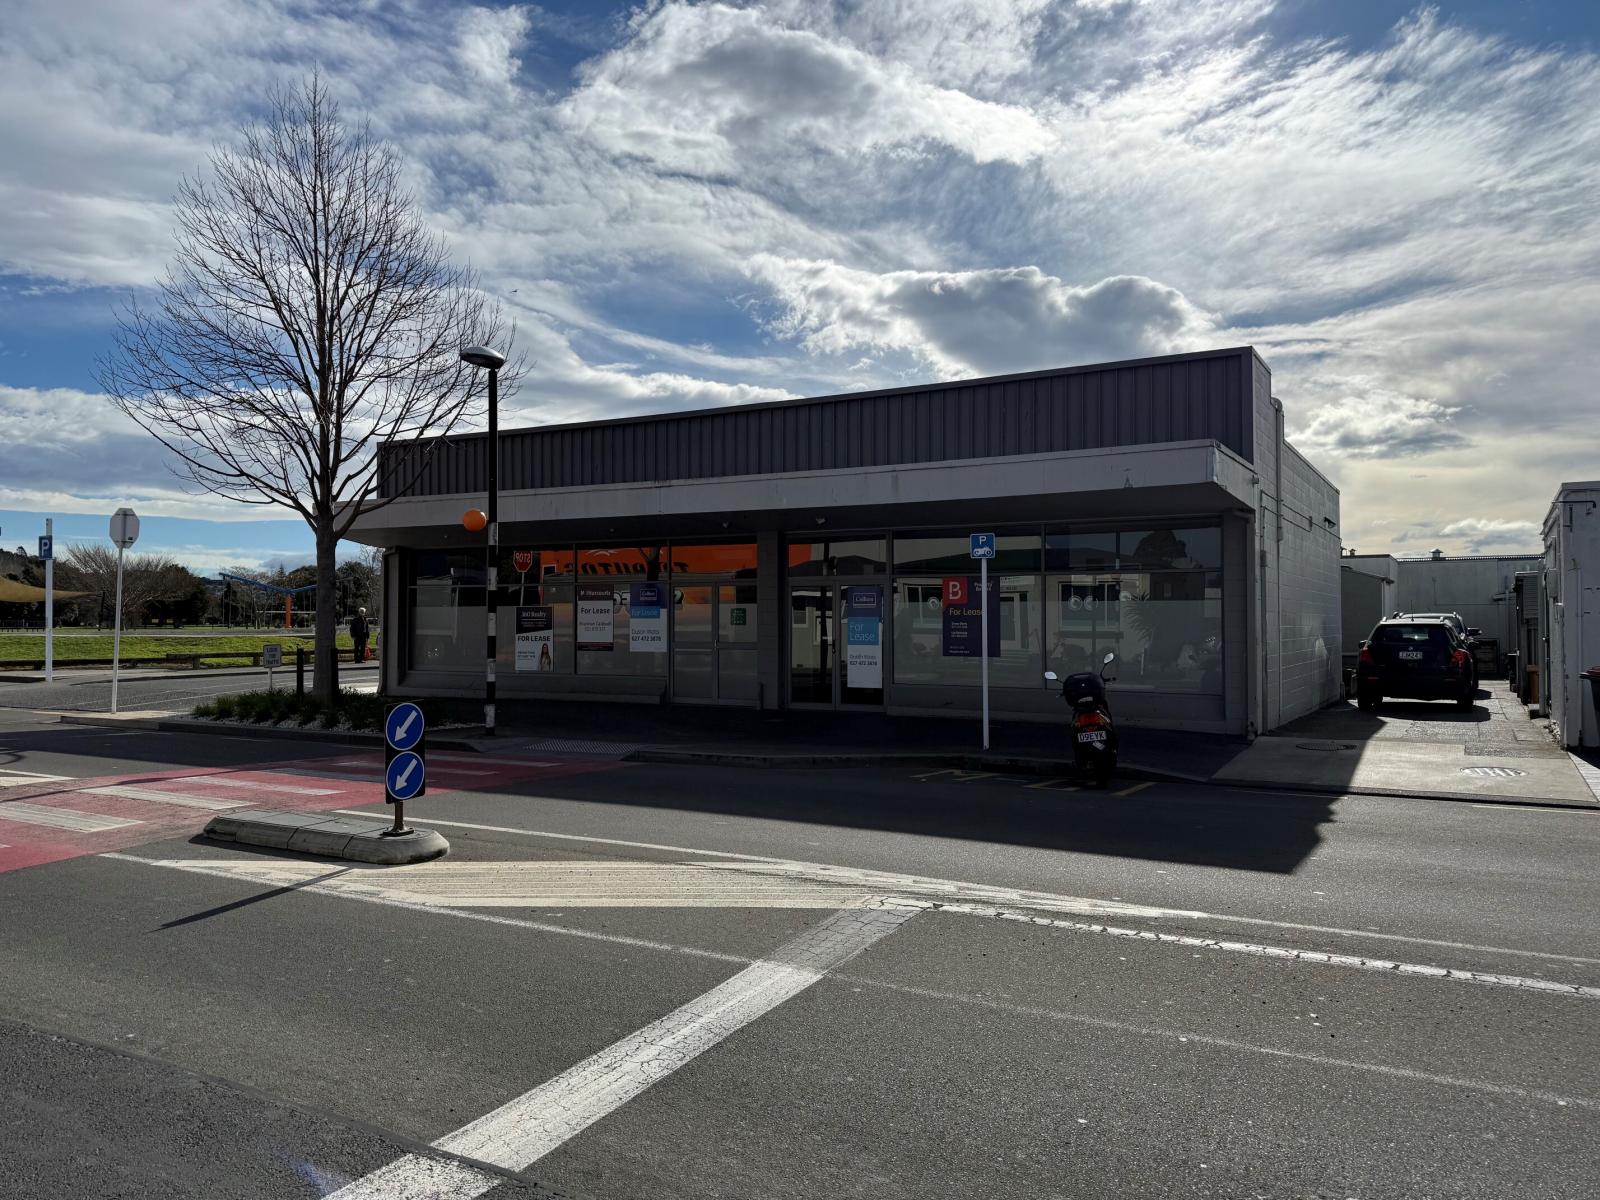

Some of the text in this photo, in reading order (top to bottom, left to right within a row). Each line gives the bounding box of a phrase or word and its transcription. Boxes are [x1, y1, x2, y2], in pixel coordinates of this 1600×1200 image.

[979, 535, 987, 545] P
[41, 539, 50, 556] P
[949, 581, 962, 600] B
[949, 608, 962, 616] For
[849, 623, 864, 631] For
[849, 632, 874, 641] Lease
